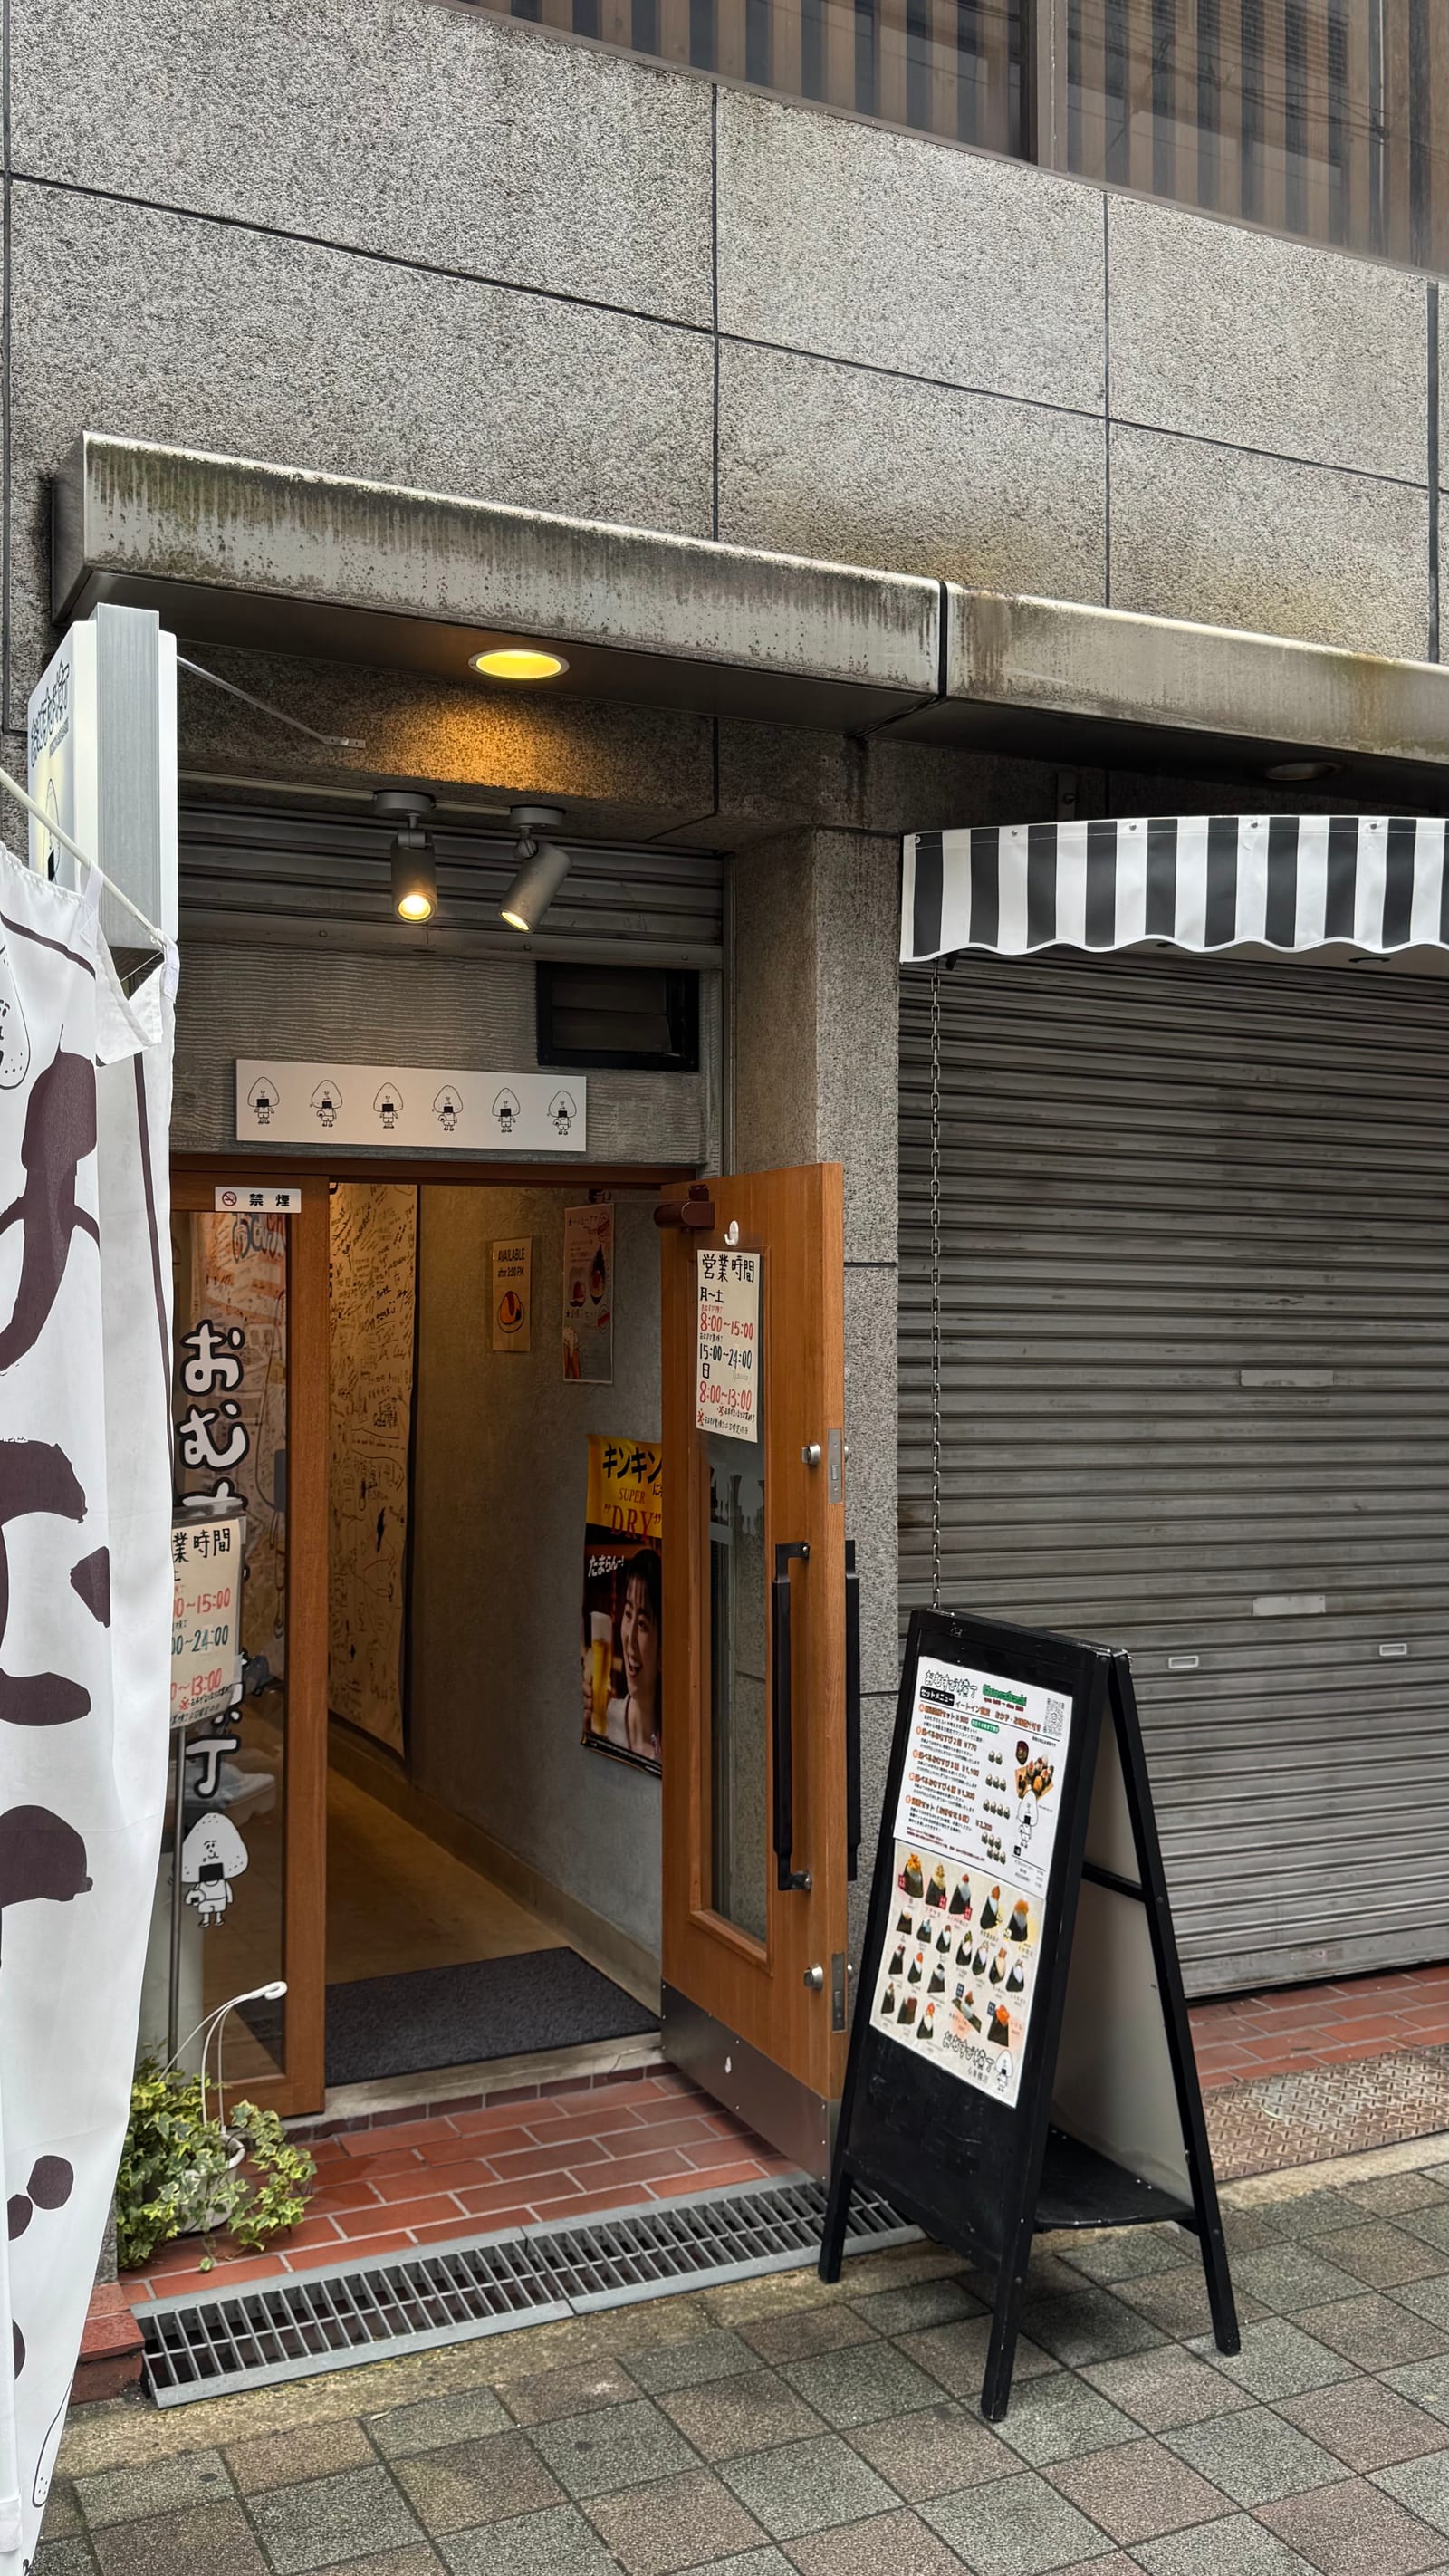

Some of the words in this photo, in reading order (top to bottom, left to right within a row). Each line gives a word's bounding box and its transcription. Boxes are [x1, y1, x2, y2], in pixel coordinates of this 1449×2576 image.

[248, 1192, 291, 1207] 禁煙
[701, 1254, 755, 1283] 営業時間
[702, 1363, 711, 1379] 日
[601, 1443, 663, 1484] キンキン
[619, 1487, 646, 1505] SUPER
[173, 1586, 231, 1616] 0~15:00
[920, 1687, 955, 1705] セットメニュー
